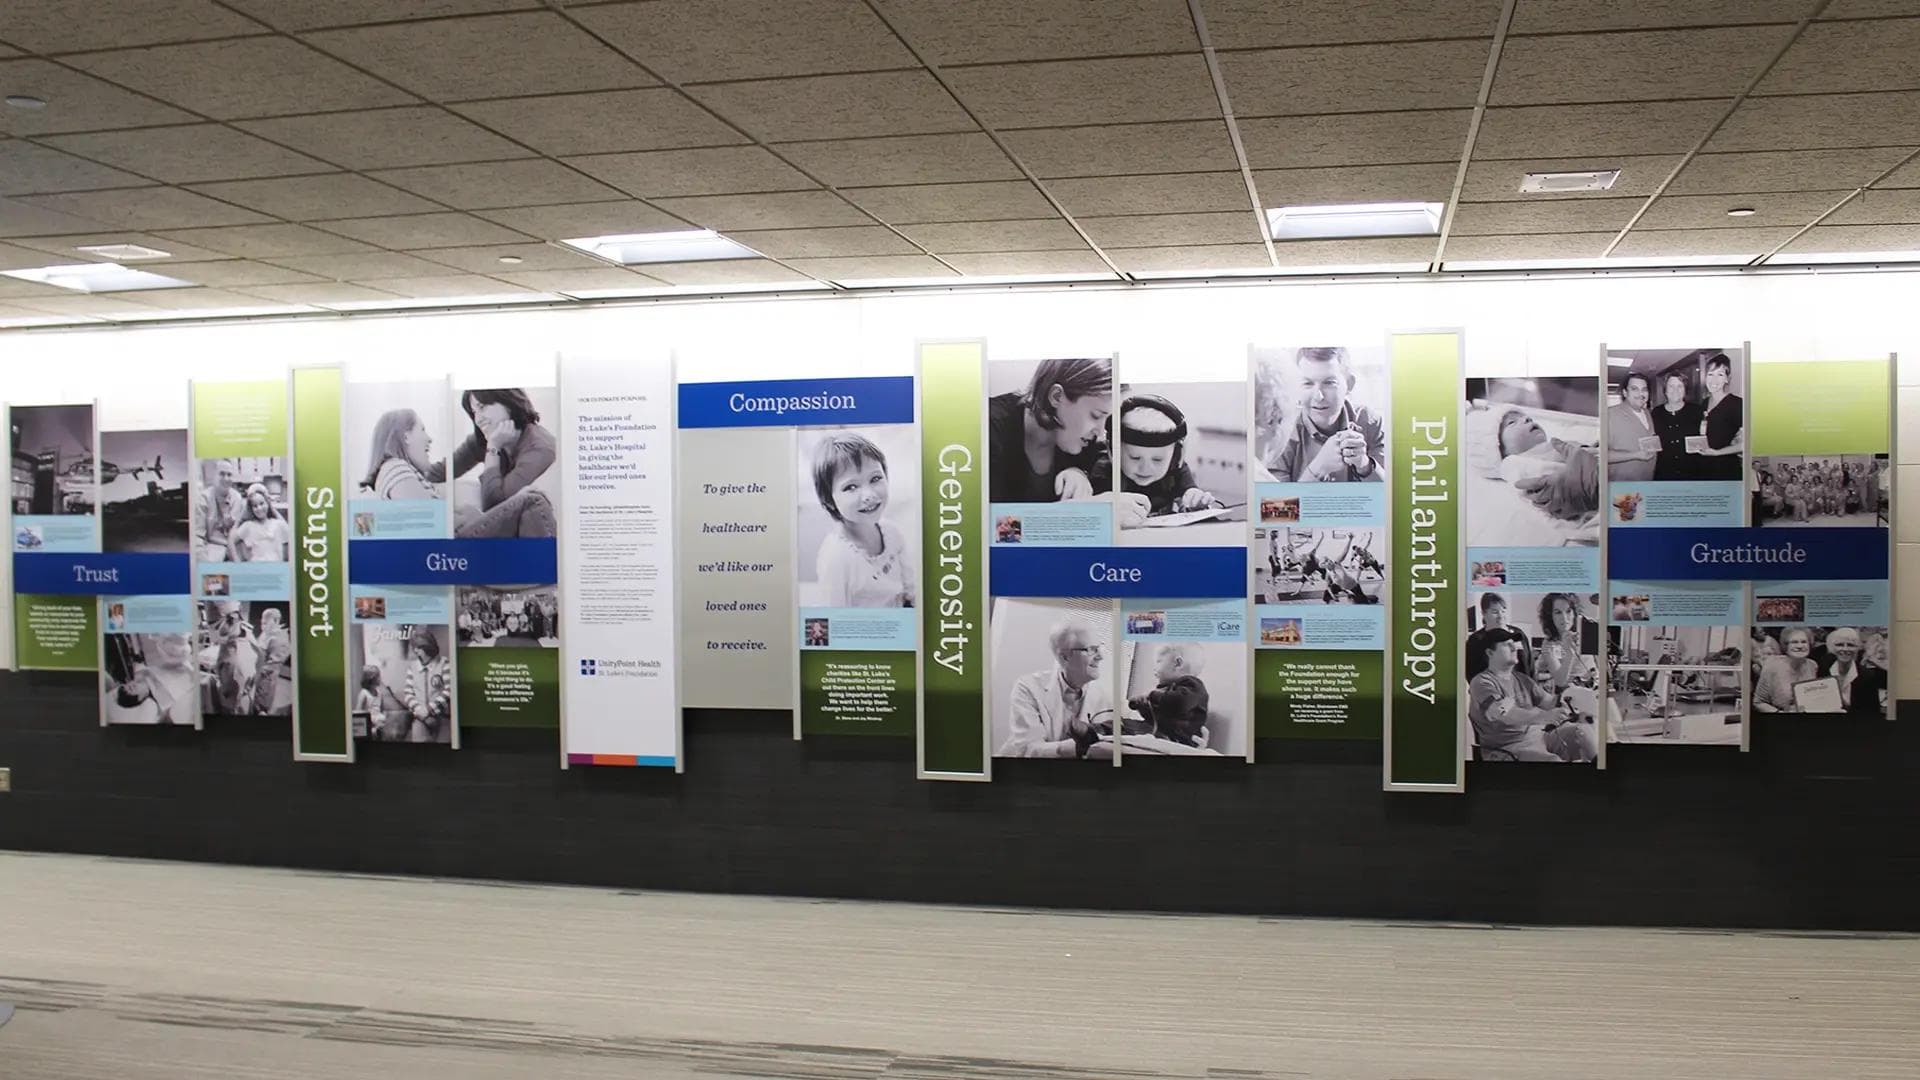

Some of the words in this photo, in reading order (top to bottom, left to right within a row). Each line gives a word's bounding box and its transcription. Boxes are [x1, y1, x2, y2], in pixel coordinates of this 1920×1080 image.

[729, 391, 857, 415] Compassion
[589, 424, 613, 432] Luke's
[614, 423, 657, 431] Foundation
[595, 434, 624, 443] support
[589, 444, 613, 452] Luke's
[614, 443, 646, 452] Hospital
[578, 463, 618, 471] healthcare
[607, 472, 628, 480] loved
[703, 484, 719, 495] To
[719, 483, 745, 497] give
[747, 483, 767, 494] the
[702, 522, 768, 533] healthcare
[932, 443, 974, 675] Generosity
[1690, 542, 1806, 564] Gratitude
[303, 486, 335, 638] Support
[426, 553, 468, 572] Give
[1402, 416, 1449, 704] Philanthropy
[698, 561, 725, 573] we'd
[726, 561, 750, 572] like
[751, 563, 774, 572] our
[1089, 562, 1142, 583] Care
[73, 565, 120, 582] Trust
[705, 600, 738, 612] loved
[739, 602, 768, 611] ones
[1217, 621, 1240, 631] iCare
[706, 640, 720, 650] to
[720, 639, 768, 651] receive.
[598, 659, 636, 669] UnityPoint
[637, 660, 662, 668] Health
[1297, 663, 1315, 671] really
[1326, 671, 1350, 679] enough
[1295, 693, 1311, 701] huge
